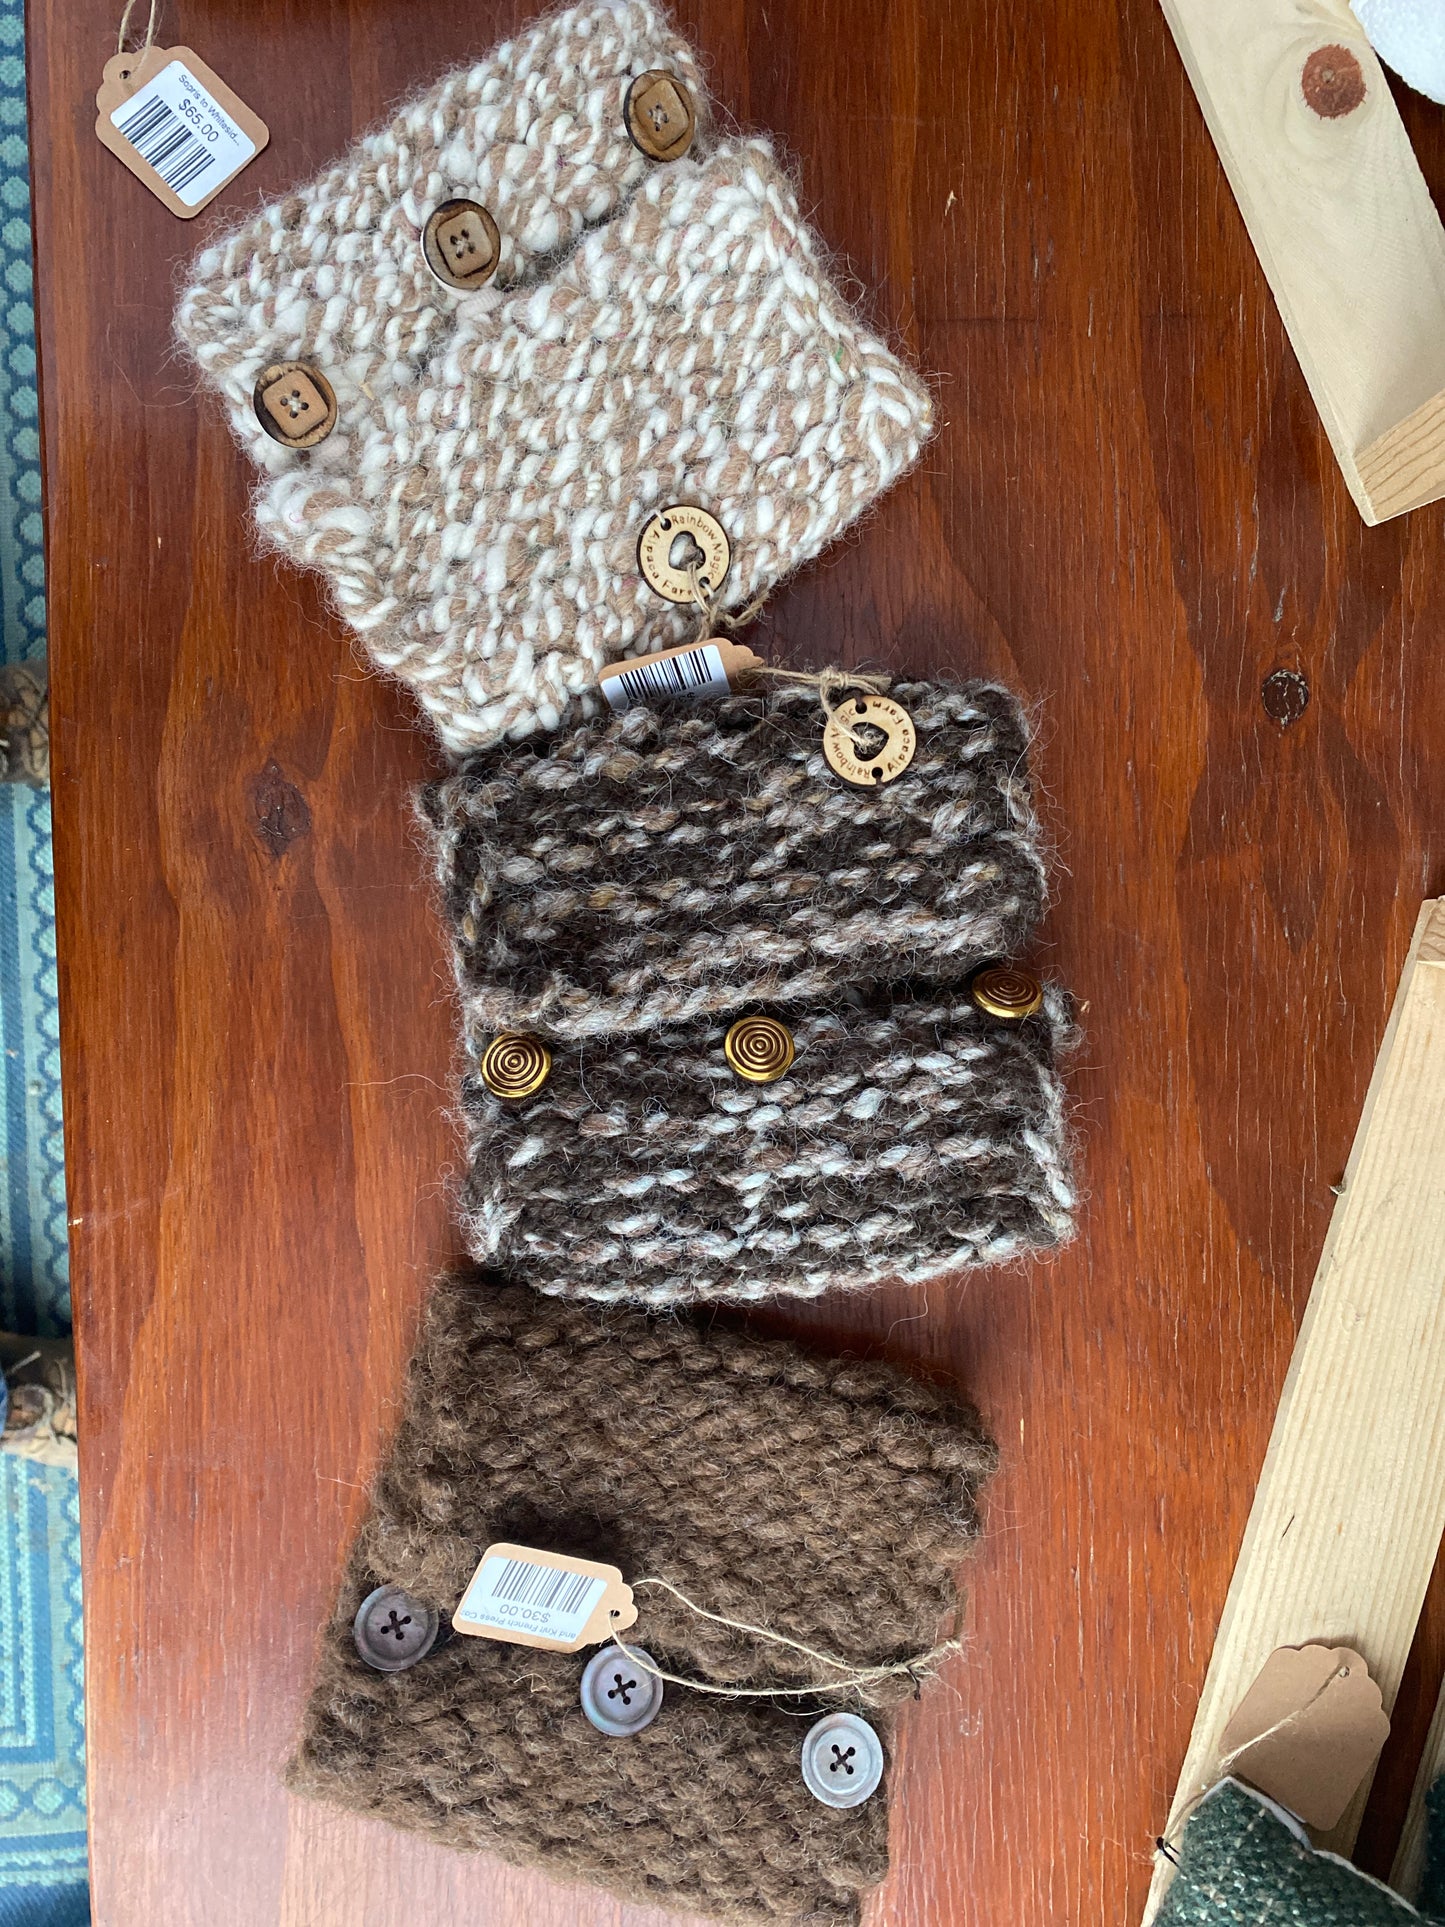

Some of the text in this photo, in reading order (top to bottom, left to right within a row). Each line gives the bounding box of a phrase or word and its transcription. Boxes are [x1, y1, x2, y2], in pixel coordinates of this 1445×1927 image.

[200, 98, 208, 108] to
[178, 98, 219, 141] $65.00
[644, 530, 660, 579] Alpaca
[671, 513, 723, 579] Rainbow Magic
[831, 708, 870, 778] Rainbow Mgic
[873, 701, 910, 772] Alpaca Farm
[480, 1615, 505, 1626] Press
[499, 1604, 551, 1623] $30.00
[507, 1620, 538, 1632] French
[540, 1626, 559, 1637] Knit
[559, 1629, 576, 1639] and
